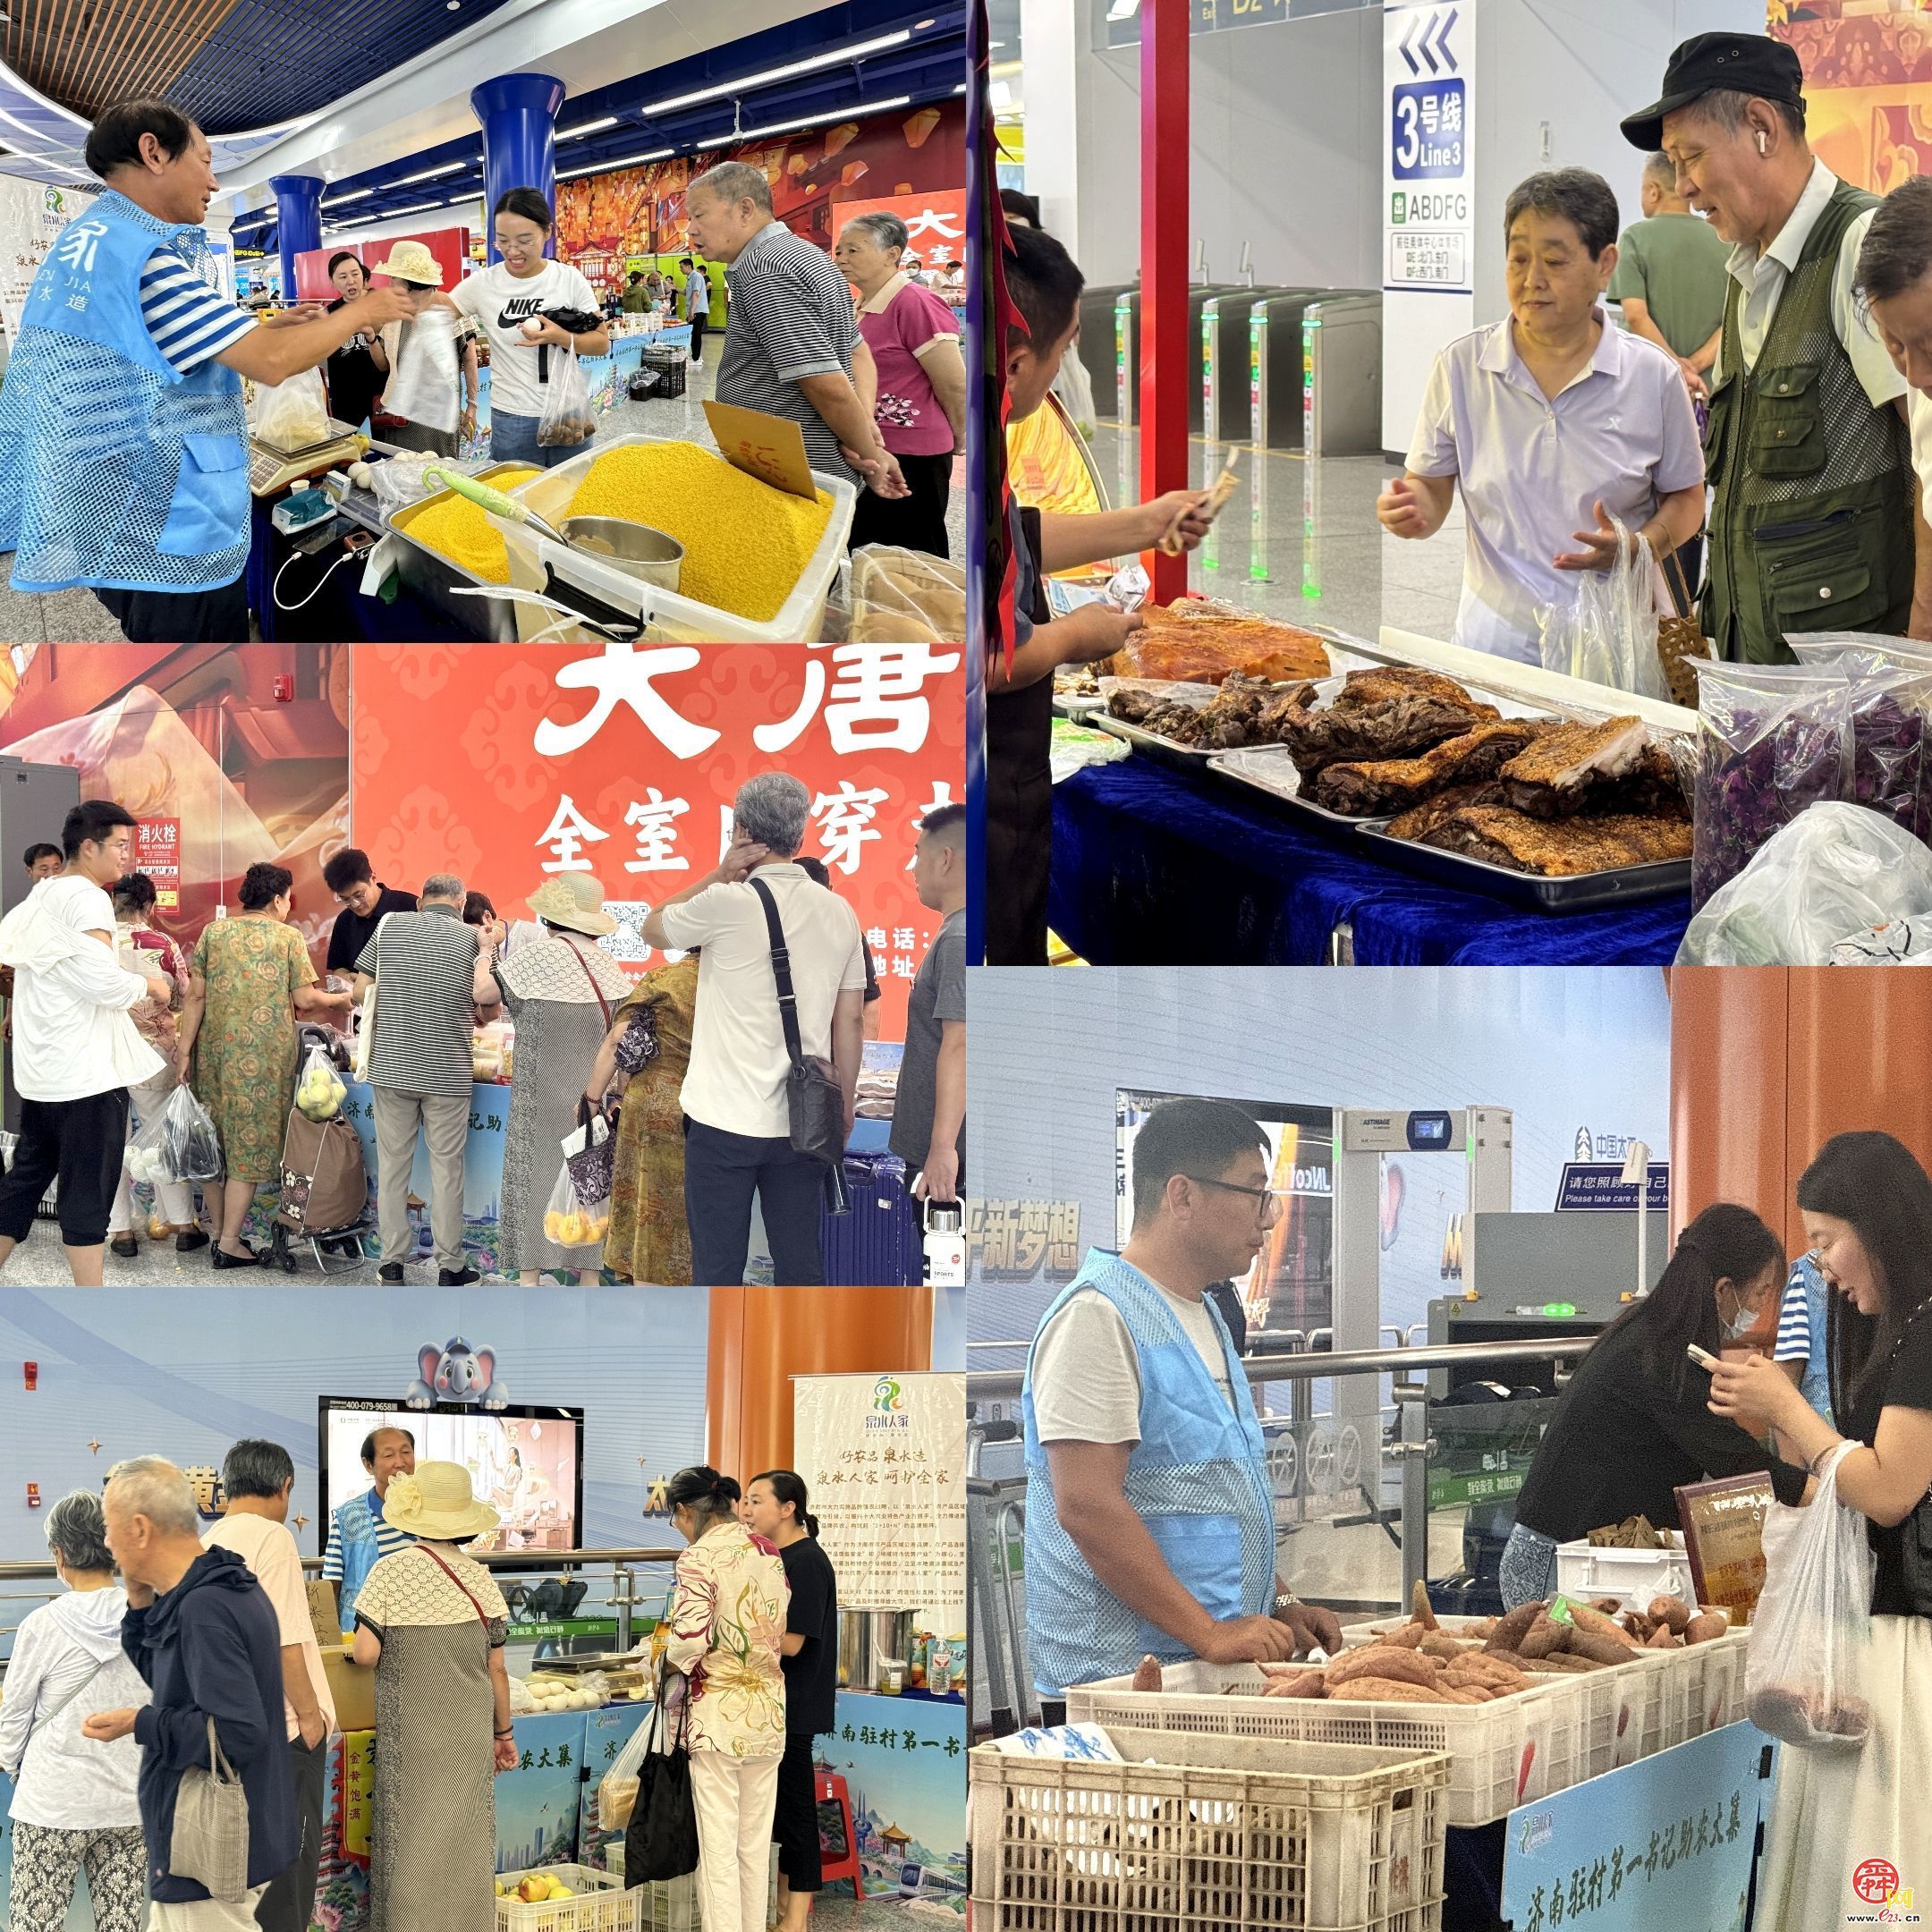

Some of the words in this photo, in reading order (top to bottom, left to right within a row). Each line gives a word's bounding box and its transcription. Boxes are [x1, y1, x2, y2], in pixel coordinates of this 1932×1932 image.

[1409, 194, 1467, 221] ABDFG
[905, 208, 965, 239] 大
[30, 238, 55, 250] 好农
[57, 220, 108, 272] 家
[15, 253, 45, 267] 泉水
[64, 275, 91, 293] JIA
[506, 298, 544, 315] NIKE
[533, 643, 962, 760] 大唐
[138, 823, 177, 843] 消火栓
[534, 780, 966, 876] 全室穿
[623, 971, 648, 981] 公众
[1596, 1133, 1637, 1159] 中国太
[1564, 1194, 1593, 1203] Please
[1594, 1194, 1612, 1203] take
[346, 1401, 392, 1411] 400-079-9658
[865, 1414, 909, 1429] 泉水人家
[884, 1469, 950, 1486] 呵护全家
[643, 1473, 672, 1513] 太
[822, 1723, 967, 1758] 南驻村第一书
[518, 1743, 573, 1771] 农大集
[349, 1750, 362, 1821] 金黄饱满
